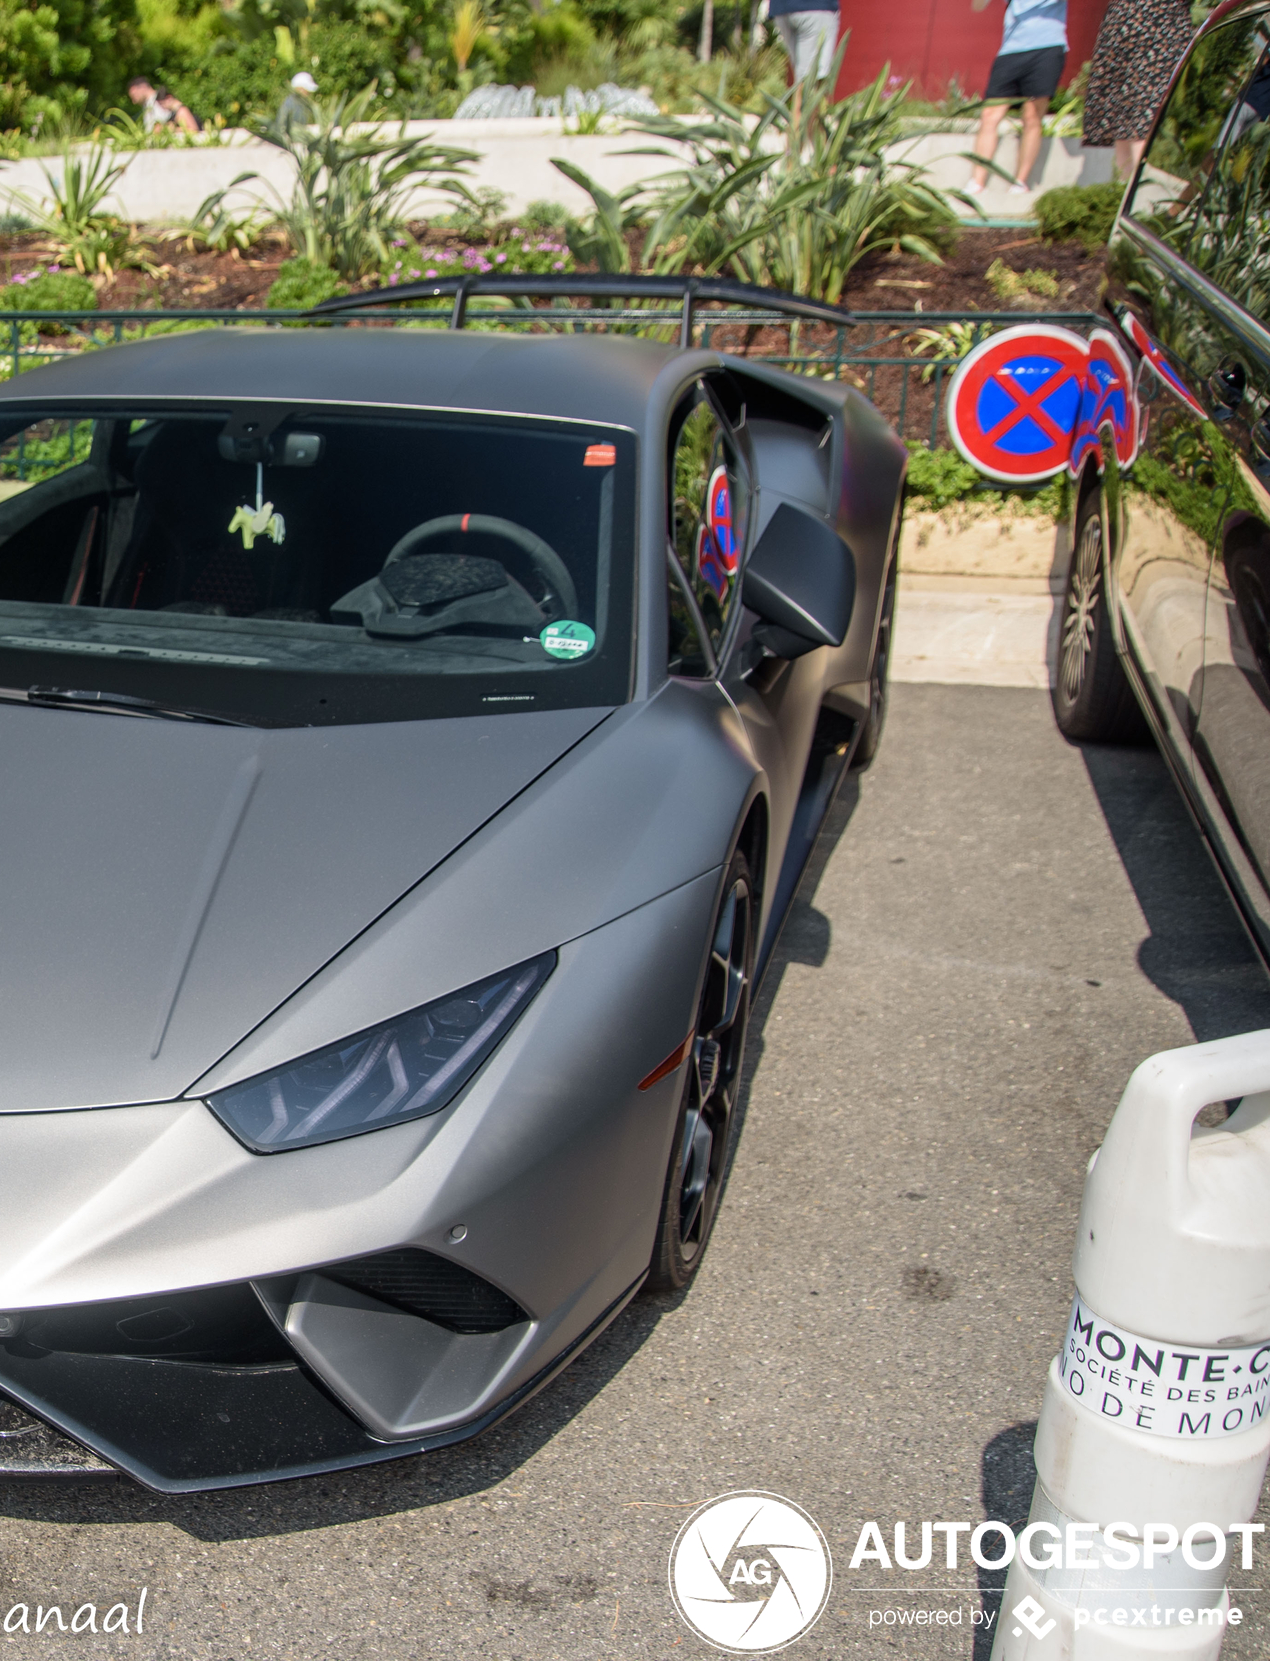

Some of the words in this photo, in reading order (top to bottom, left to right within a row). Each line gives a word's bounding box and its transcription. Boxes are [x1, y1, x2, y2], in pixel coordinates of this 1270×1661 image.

[560, 623, 575, 638] 4
[1070, 1338, 1155, 1397] SOCIÉTÉ
[1167, 1387, 1216, 1403] DES
[1101, 1391, 1155, 1430] DE
